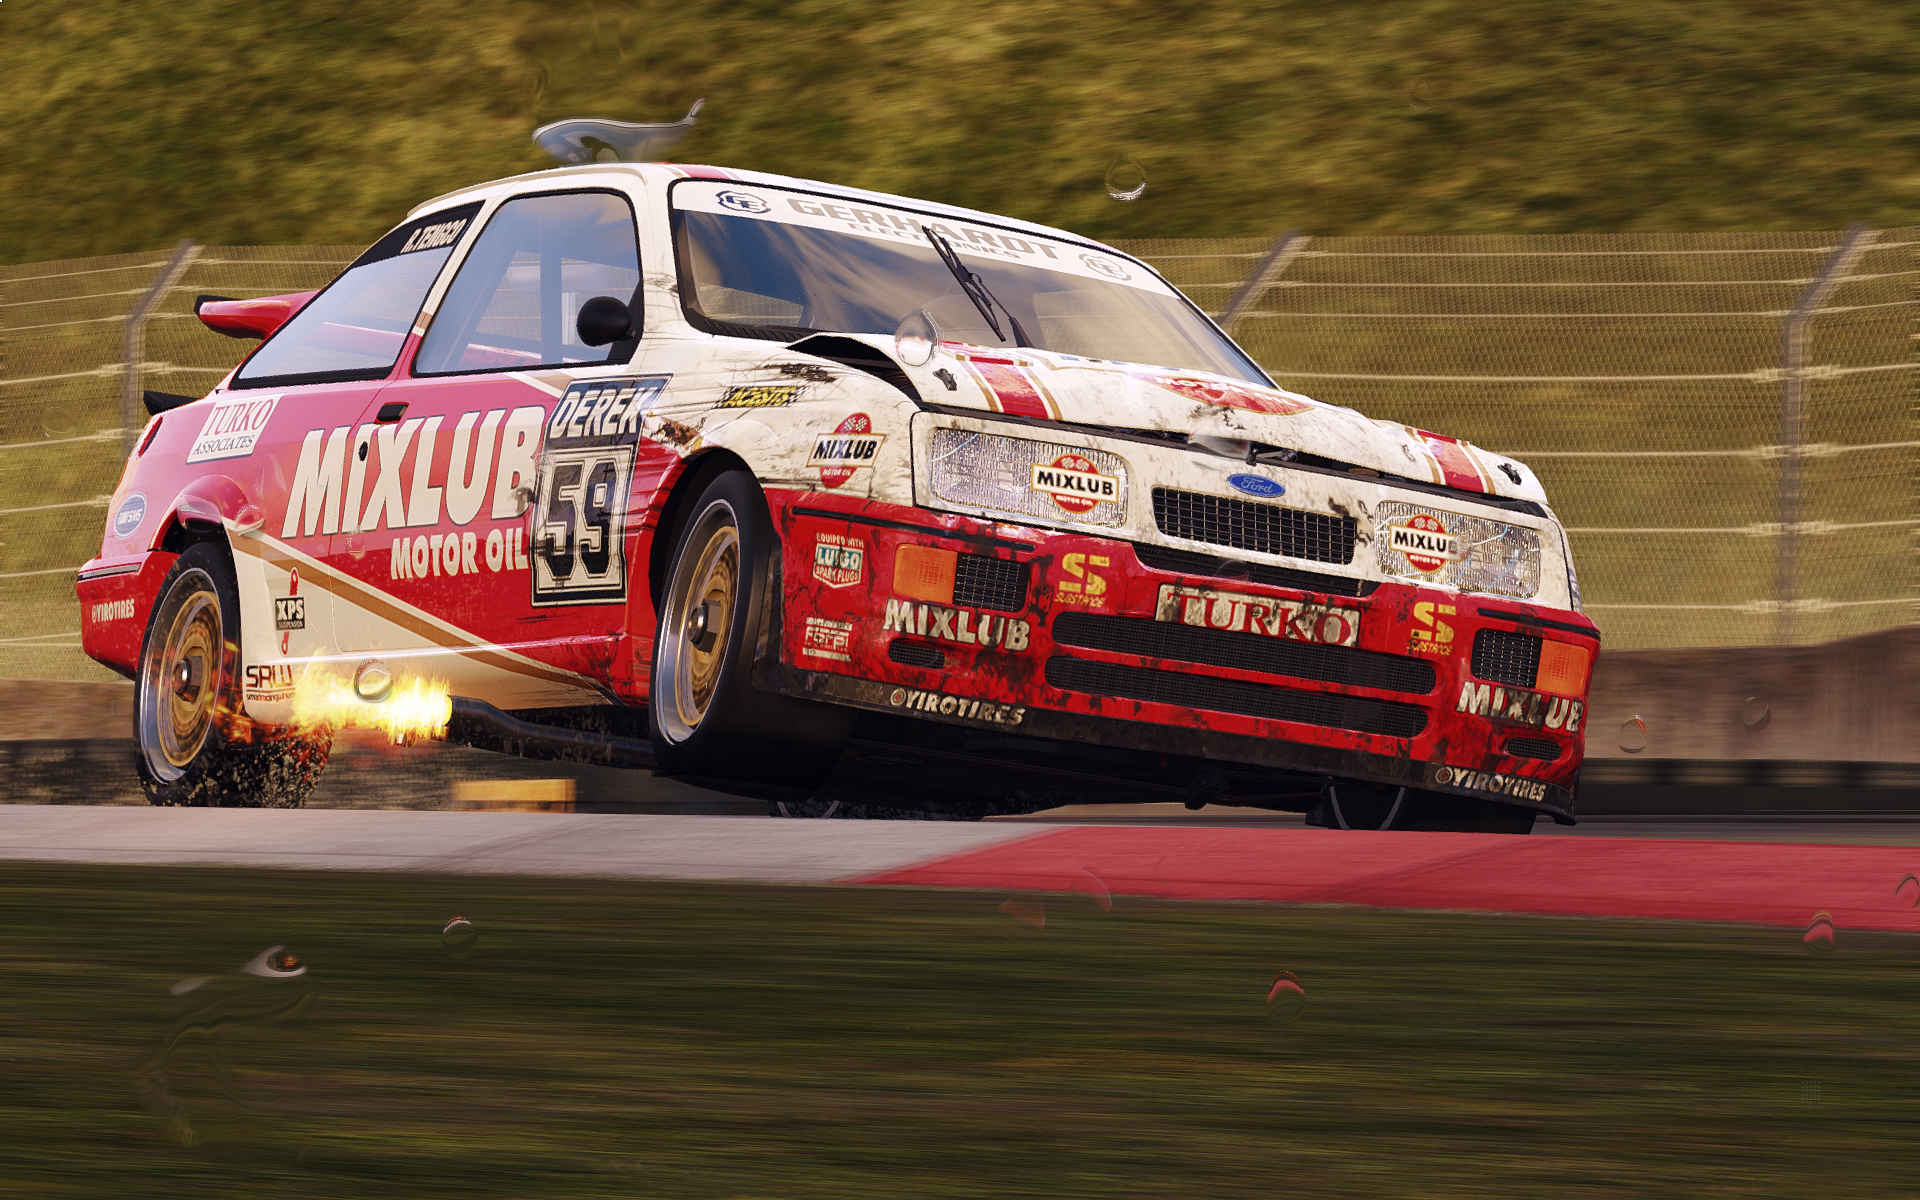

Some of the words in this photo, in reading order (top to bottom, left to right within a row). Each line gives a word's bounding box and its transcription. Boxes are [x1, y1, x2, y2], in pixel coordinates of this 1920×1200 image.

[786, 198, 1059, 260] GERHARDT
[203, 398, 274, 437] TURKO
[550, 384, 659, 439] DEREK
[192, 434, 256, 456] ASSOCIATES
[813, 439, 878, 460] MIXLUB
[281, 405, 546, 539] MIXLUB
[1037, 470, 1114, 496] MIXLUB
[1241, 476, 1274, 494] Ford
[544, 458, 618, 581] 59
[391, 532, 480, 581] MOTOR
[485, 527, 529, 573] OIL
[1394, 530, 1458, 557] MIXLU
[276, 599, 304, 620] XPS
[882, 597, 1031, 652] MIXLUB
[1167, 592, 1352, 645] TURKO
[245, 664, 294, 689] SRW
